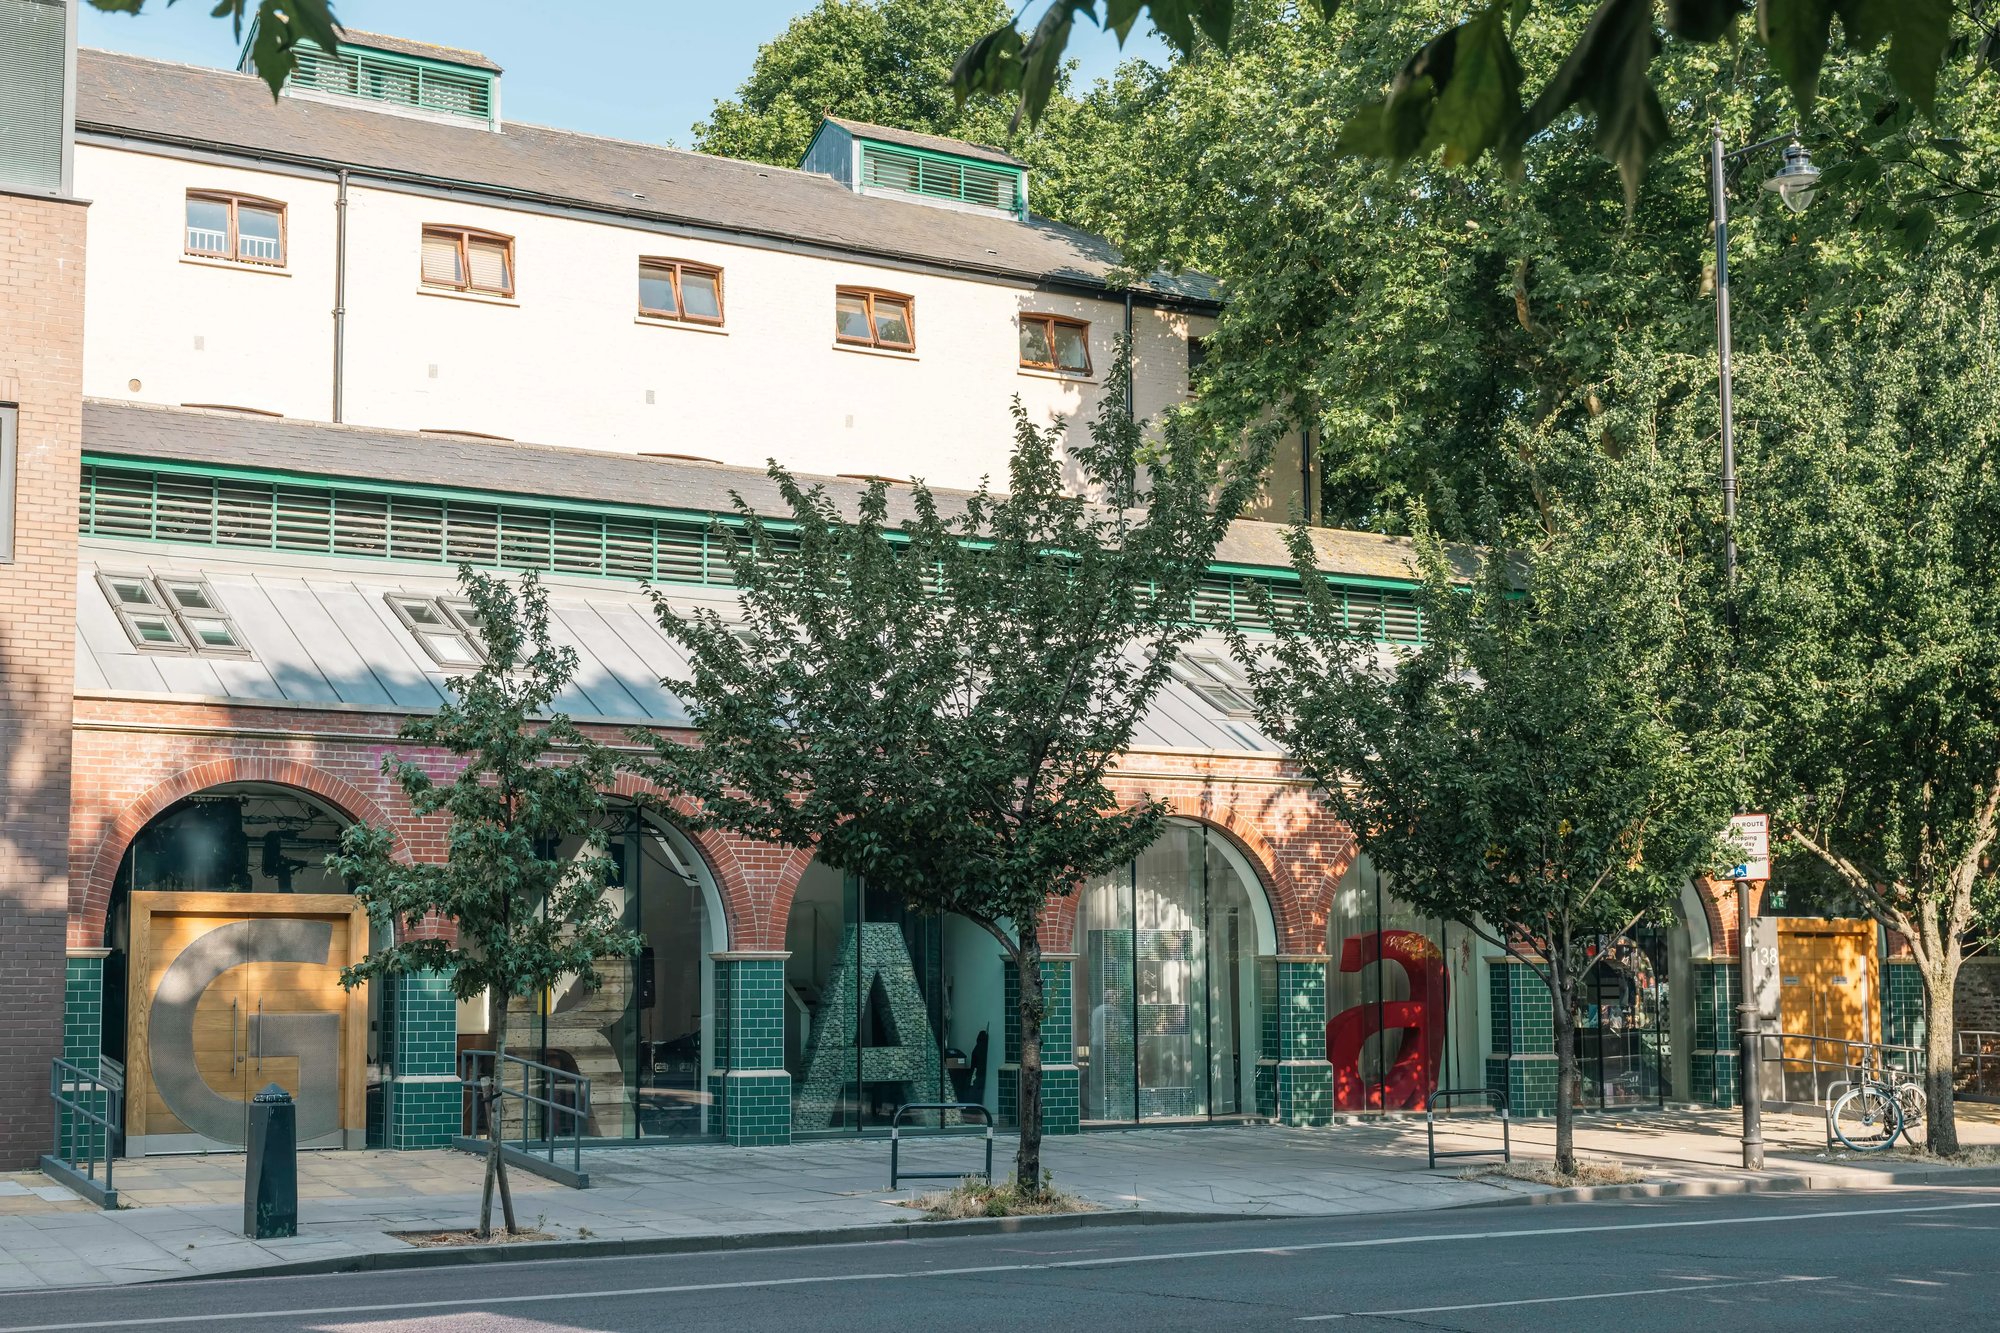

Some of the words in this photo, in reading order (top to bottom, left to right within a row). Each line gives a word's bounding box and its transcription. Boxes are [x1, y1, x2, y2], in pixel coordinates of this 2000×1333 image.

[1752, 947, 1778, 966] 138
[148, 918, 340, 1146] G
[791, 921, 963, 1133] A
[1325, 929, 1451, 1113] a
